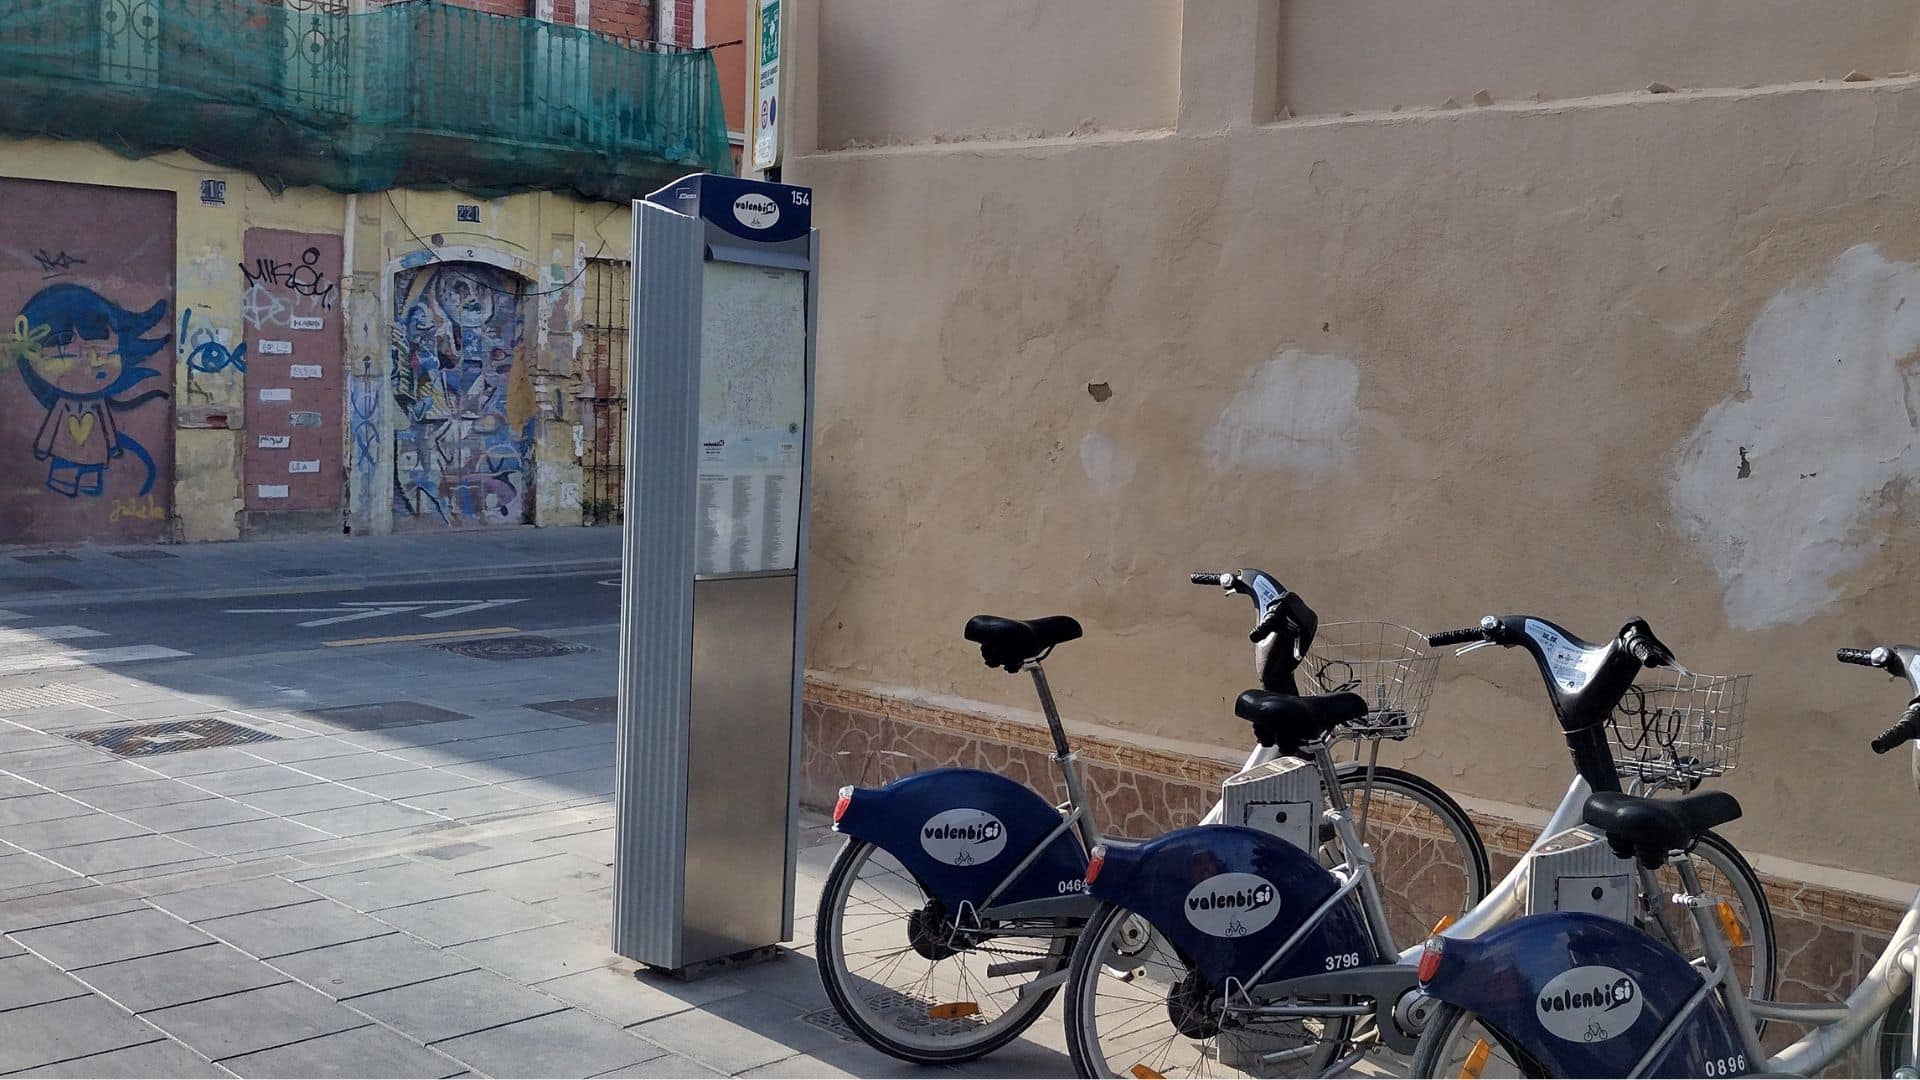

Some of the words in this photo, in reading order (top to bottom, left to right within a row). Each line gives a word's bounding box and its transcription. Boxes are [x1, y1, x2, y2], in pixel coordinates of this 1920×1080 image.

[791, 190, 810, 206] 154
[459, 205, 480, 220] 221
[924, 821, 1001, 841] valenbisi
[1188, 884, 1273, 911] valenbisi
[1325, 952, 1359, 970] 3796
[1540, 978, 1634, 1013] valenbisi
[1705, 1053, 1745, 1077] 0896
